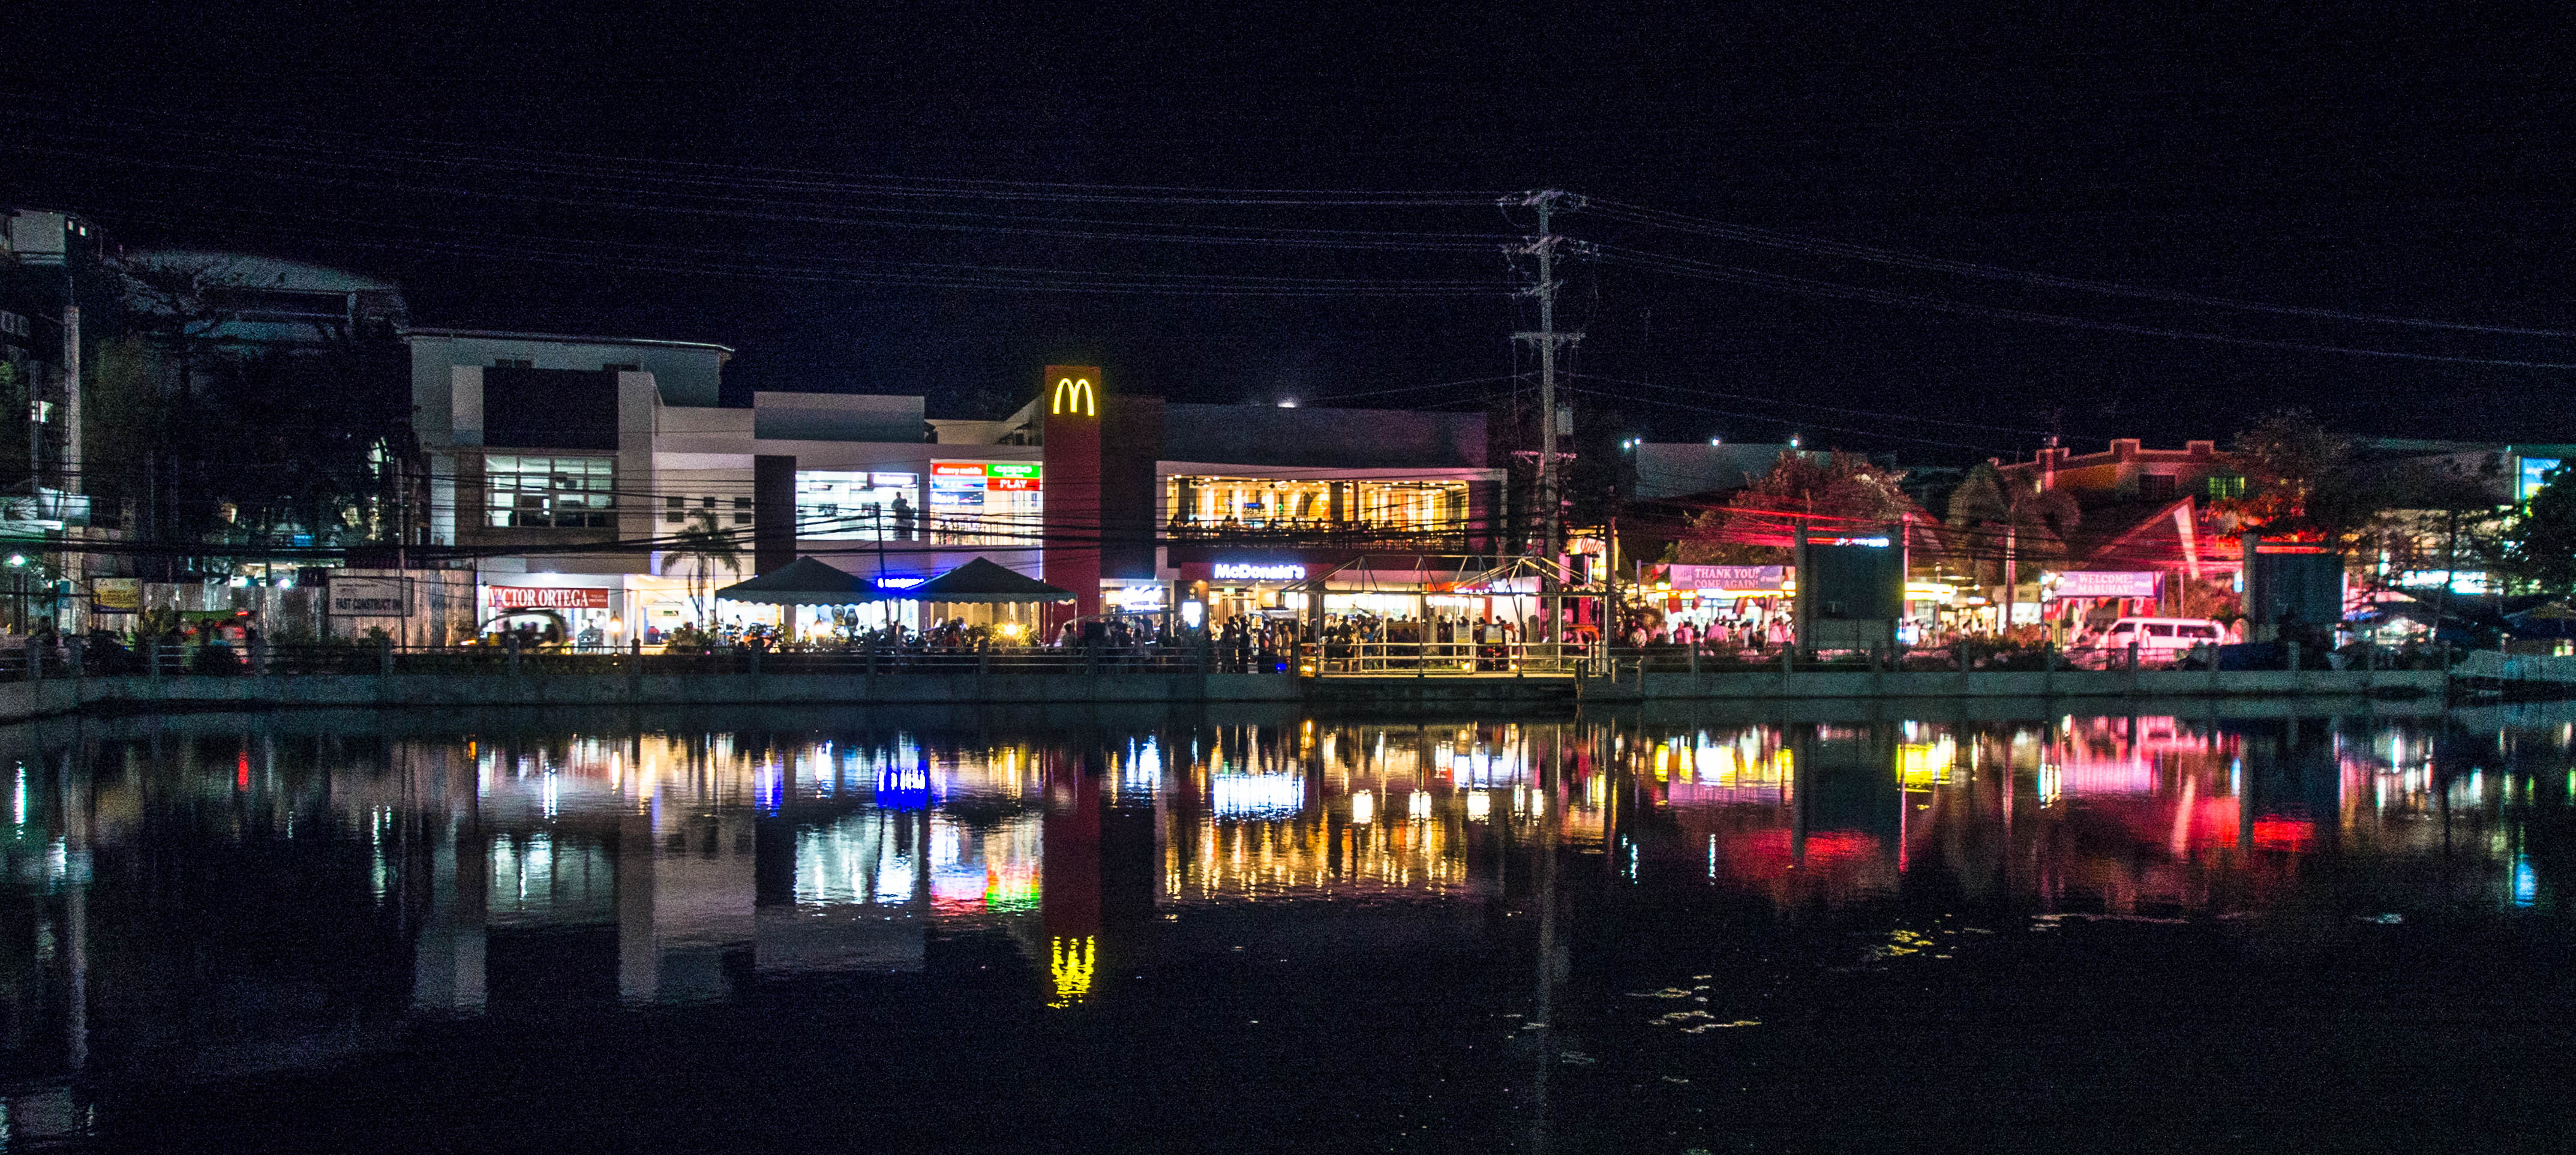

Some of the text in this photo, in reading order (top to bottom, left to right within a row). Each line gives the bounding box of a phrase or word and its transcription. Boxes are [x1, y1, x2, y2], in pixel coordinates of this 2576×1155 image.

[1000, 479, 1027, 488] PLAY
[1214, 564, 1305, 579] McDonald's
[1694, 568, 1758, 578] THANK YOU!
[2079, 574, 2133, 583] WELCOME!
[1694, 579, 1758, 589] COME AGAIN!
[2078, 584, 2133, 593] MABUHAY!
[539, 589, 589, 607] ORTEGA
